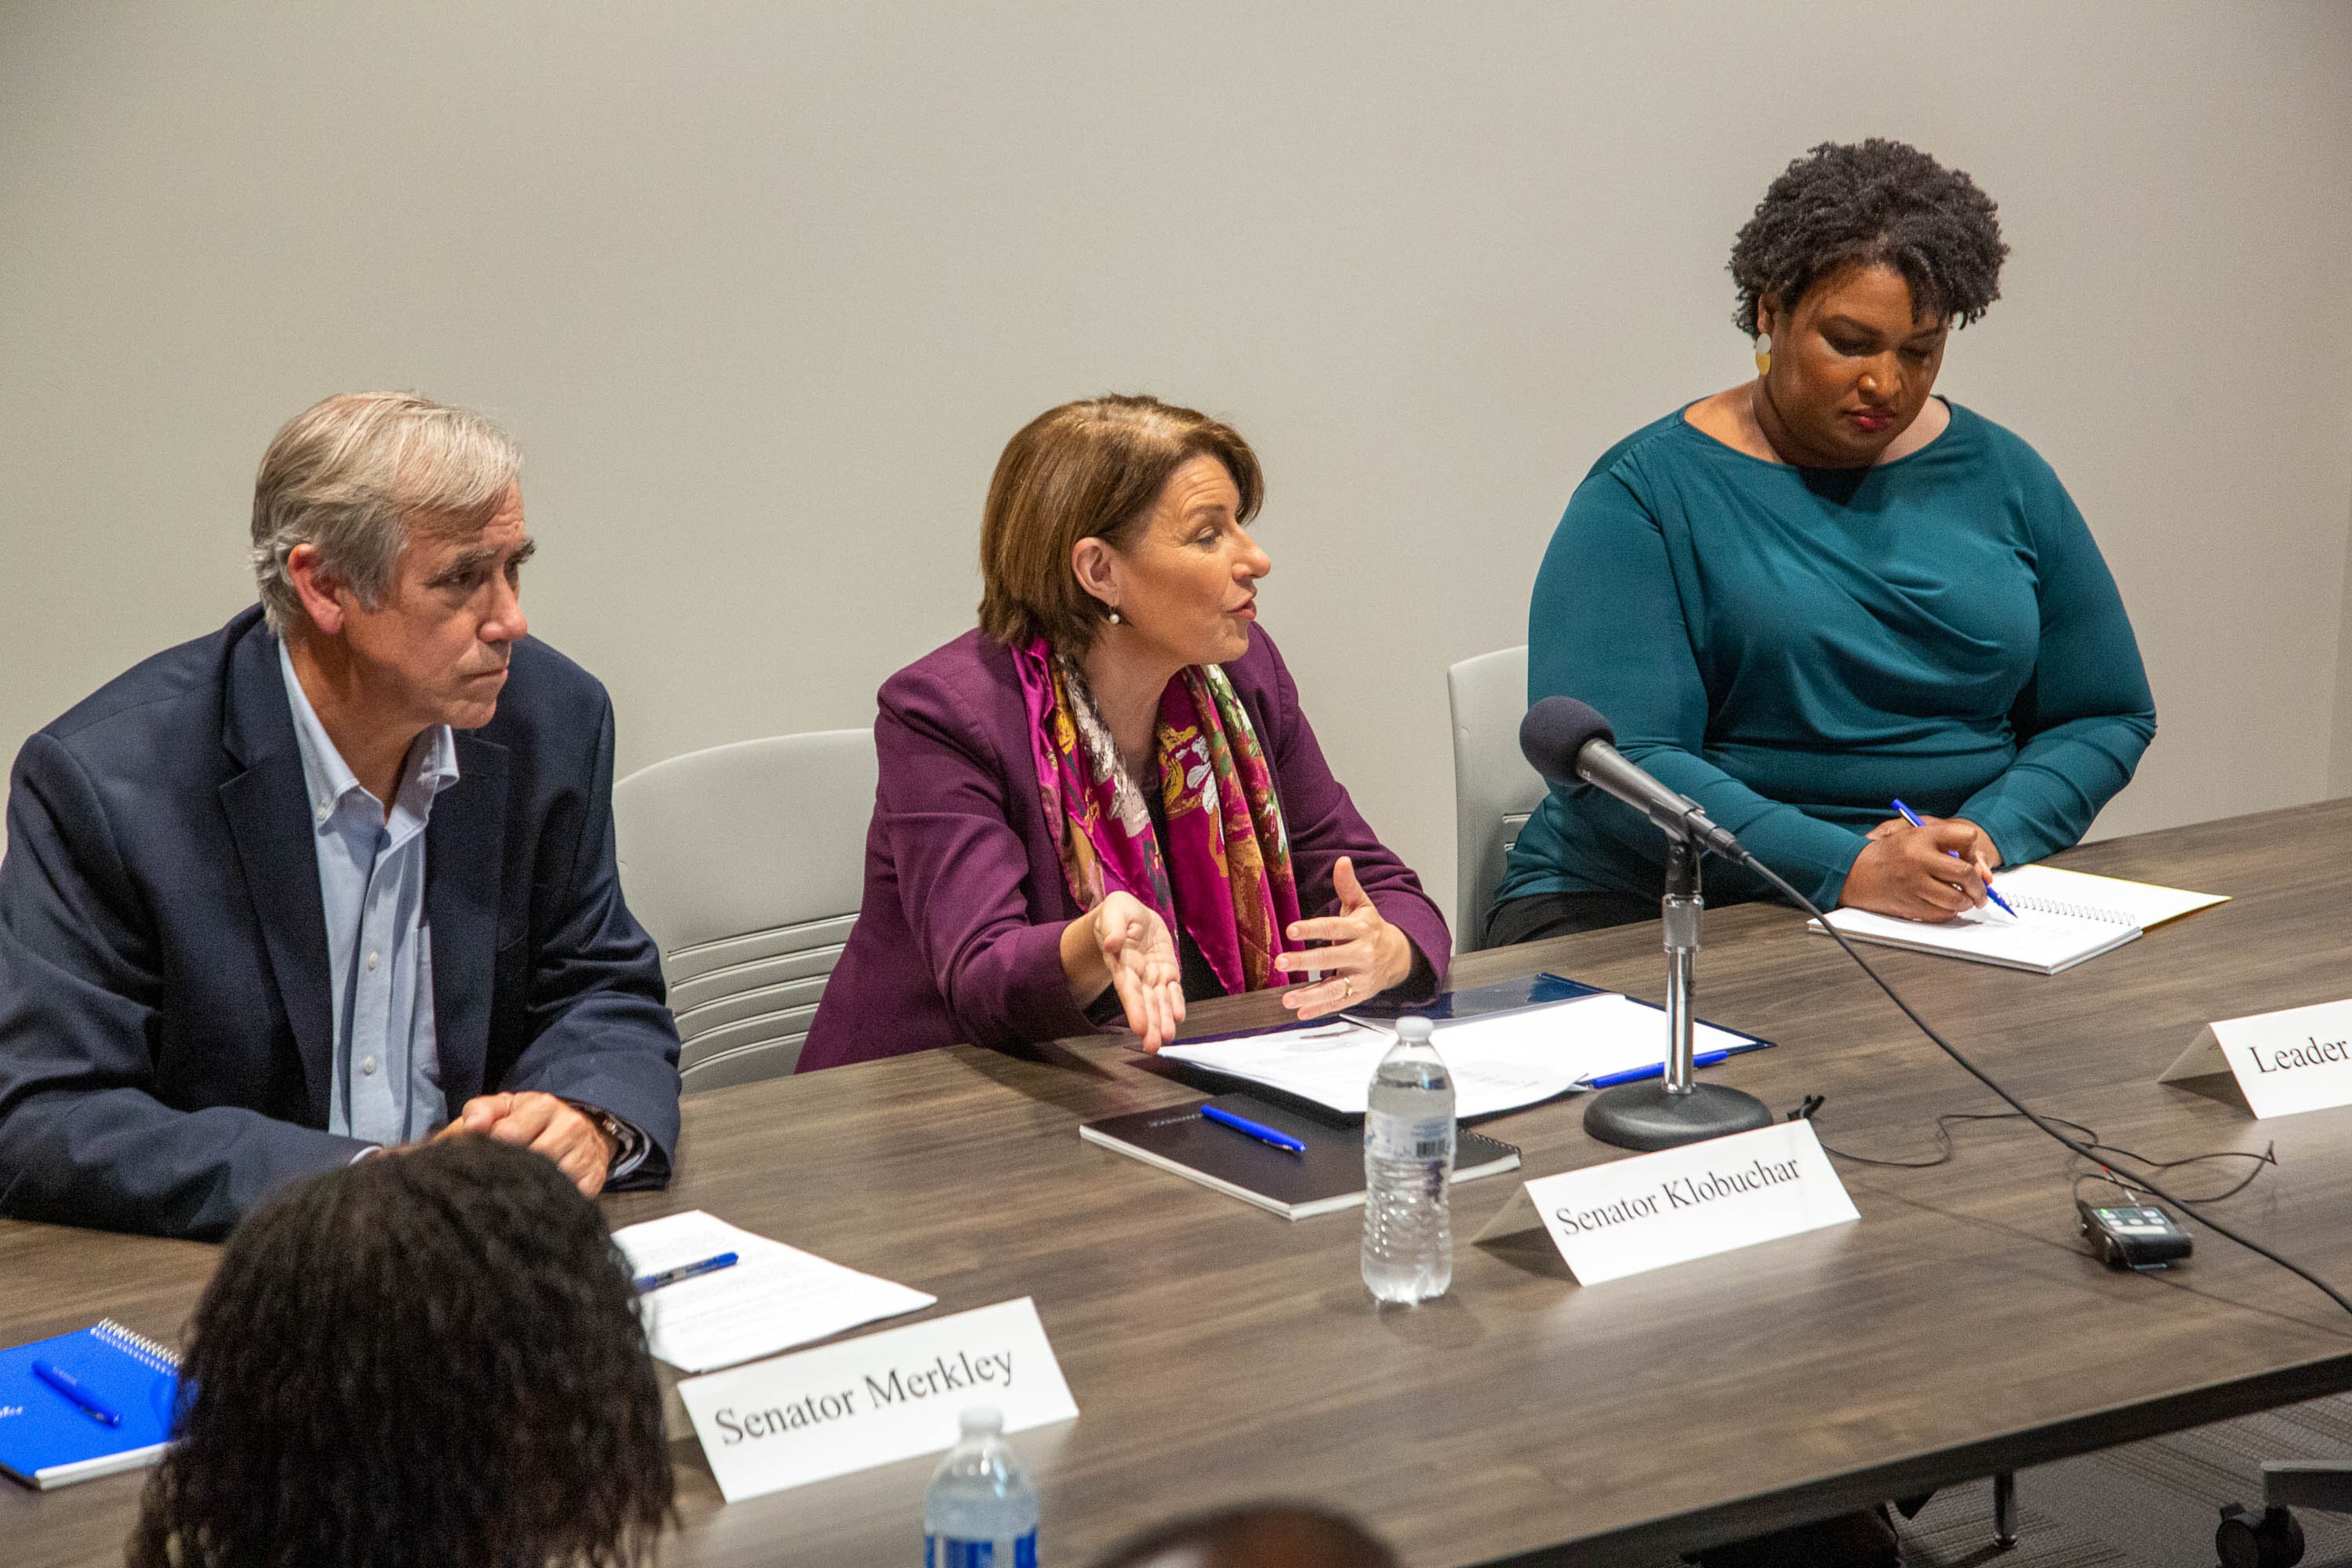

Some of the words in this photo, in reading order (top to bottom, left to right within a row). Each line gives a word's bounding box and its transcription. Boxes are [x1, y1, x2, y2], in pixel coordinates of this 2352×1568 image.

[2248, 1036, 2350, 1074] Leader
[1556, 1192, 1660, 1236] Senator
[1660, 1159, 1801, 1210] Klobuchar
[714, 1390, 855, 1446] Senator
[863, 1351, 1012, 1409] Merkley
